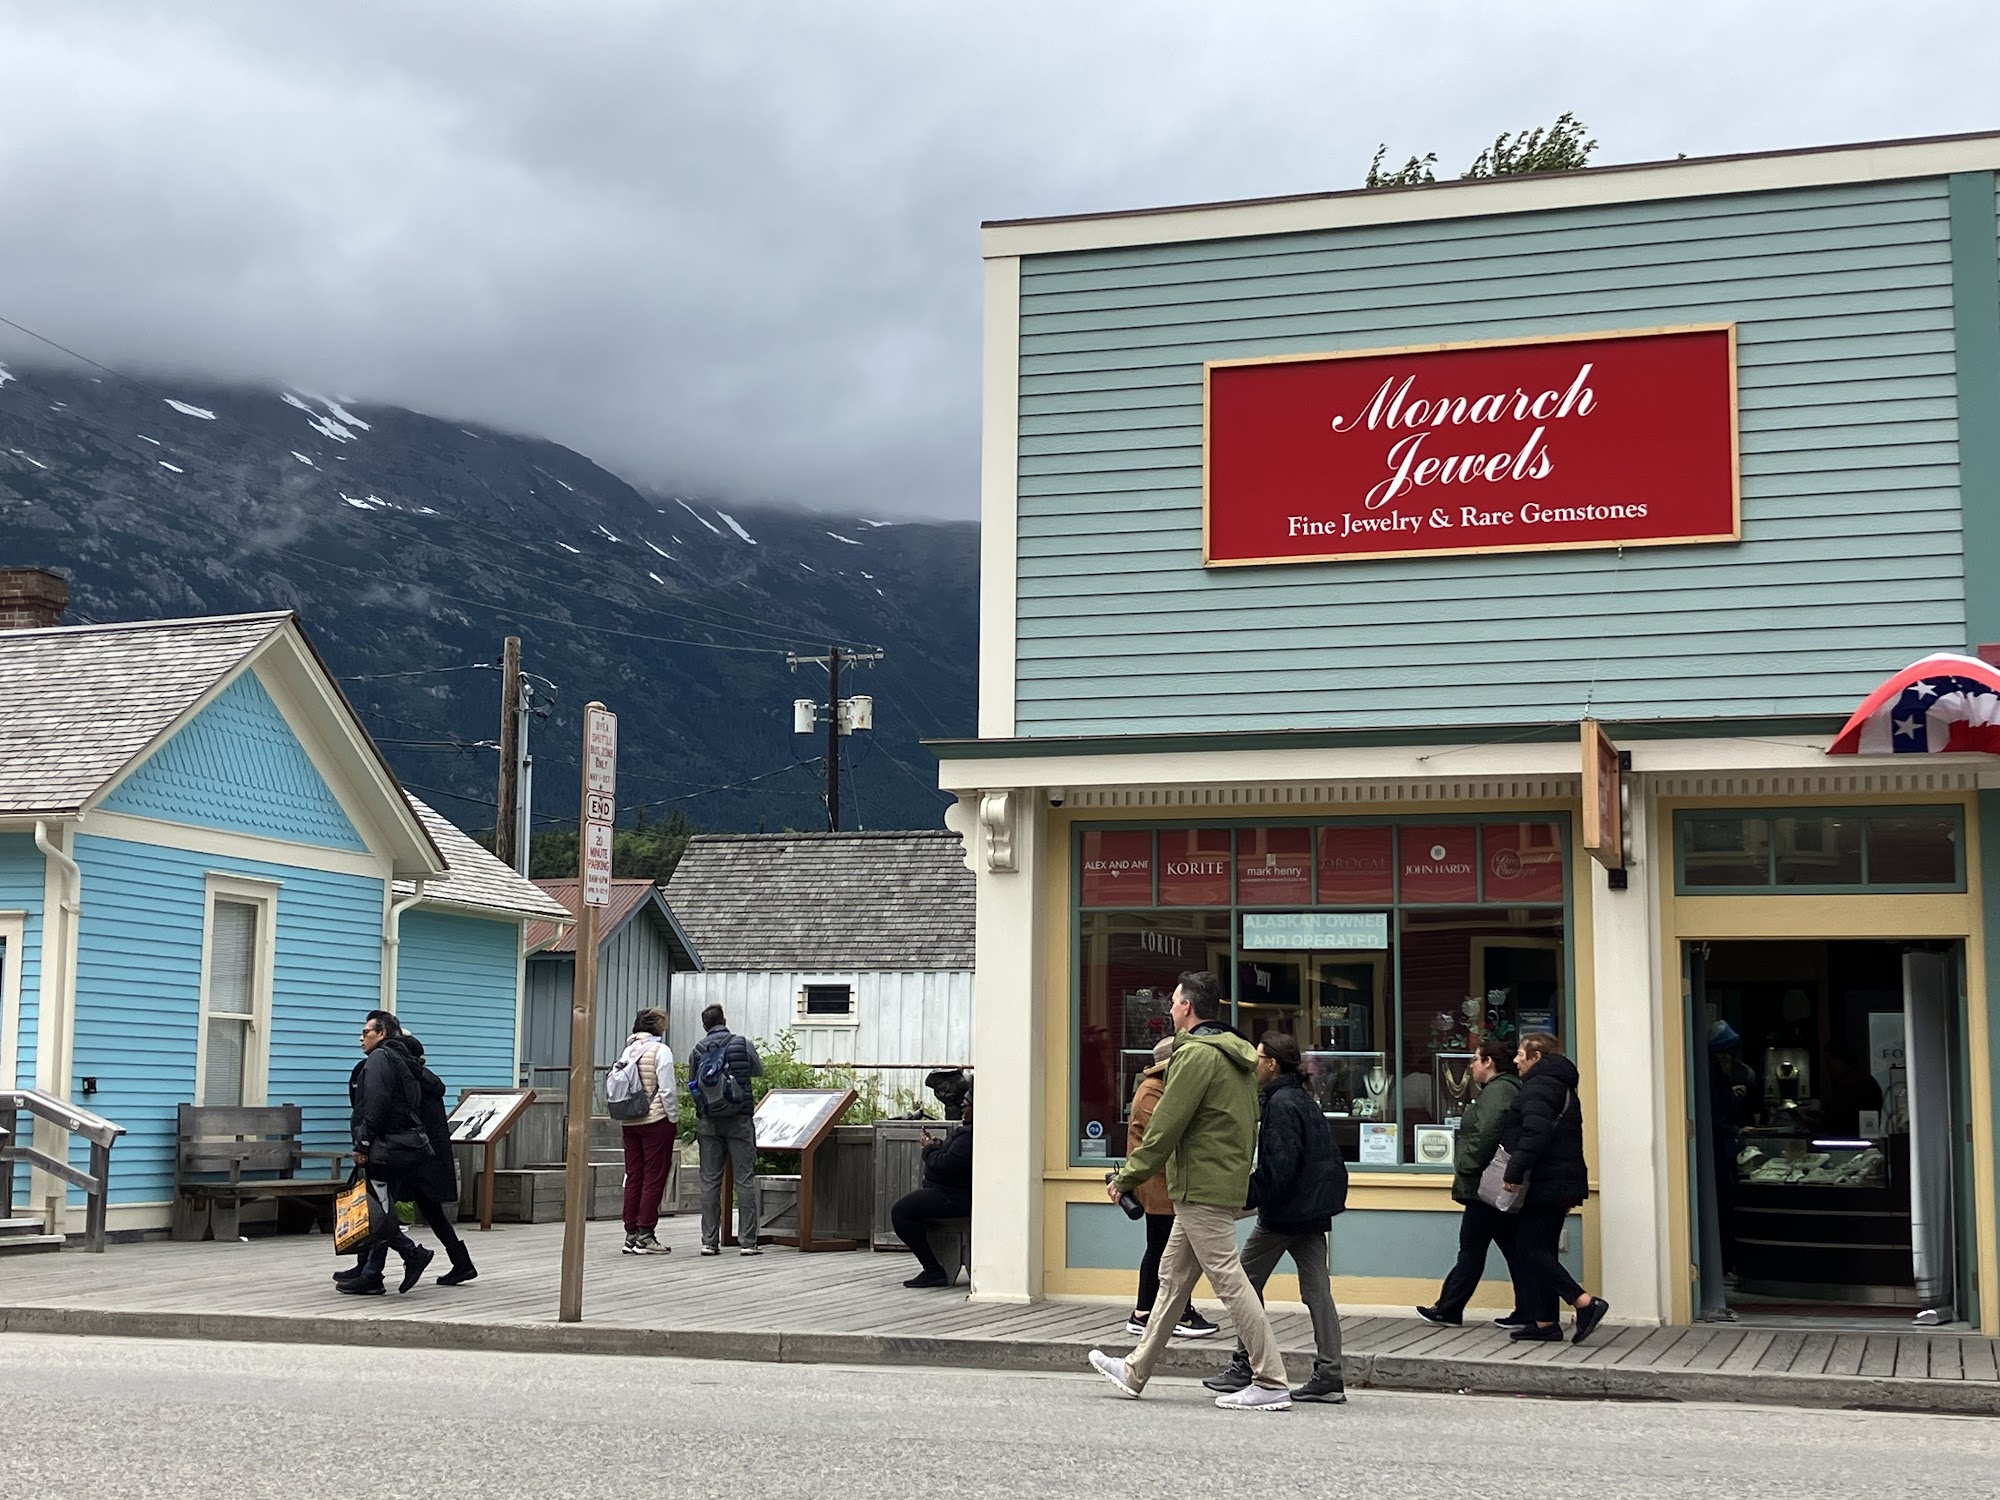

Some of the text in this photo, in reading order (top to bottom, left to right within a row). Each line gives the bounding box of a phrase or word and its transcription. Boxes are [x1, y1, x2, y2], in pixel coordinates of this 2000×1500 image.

[1331, 363, 1597, 433] Monarch
[1364, 426, 1555, 510] Jewels
[1287, 502, 1648, 538] Fine Jewelry & Rare Gemstones
[592, 800, 610, 815] END
[595, 835, 604, 846] 20
[587, 859, 610, 872] PARKING
[1084, 860, 1107, 870] ALEX
[1108, 860, 1130, 869] AND
[1167, 862, 1224, 875] KORITE
[1404, 864, 1471, 876] JOHN HARDY
[1247, 867, 1302, 878] mark henry
[1245, 914, 1385, 928] ALASKAN OWNED
[1140, 929, 1183, 958] KORITE
[1253, 933, 1378, 947] AND OPERATED
